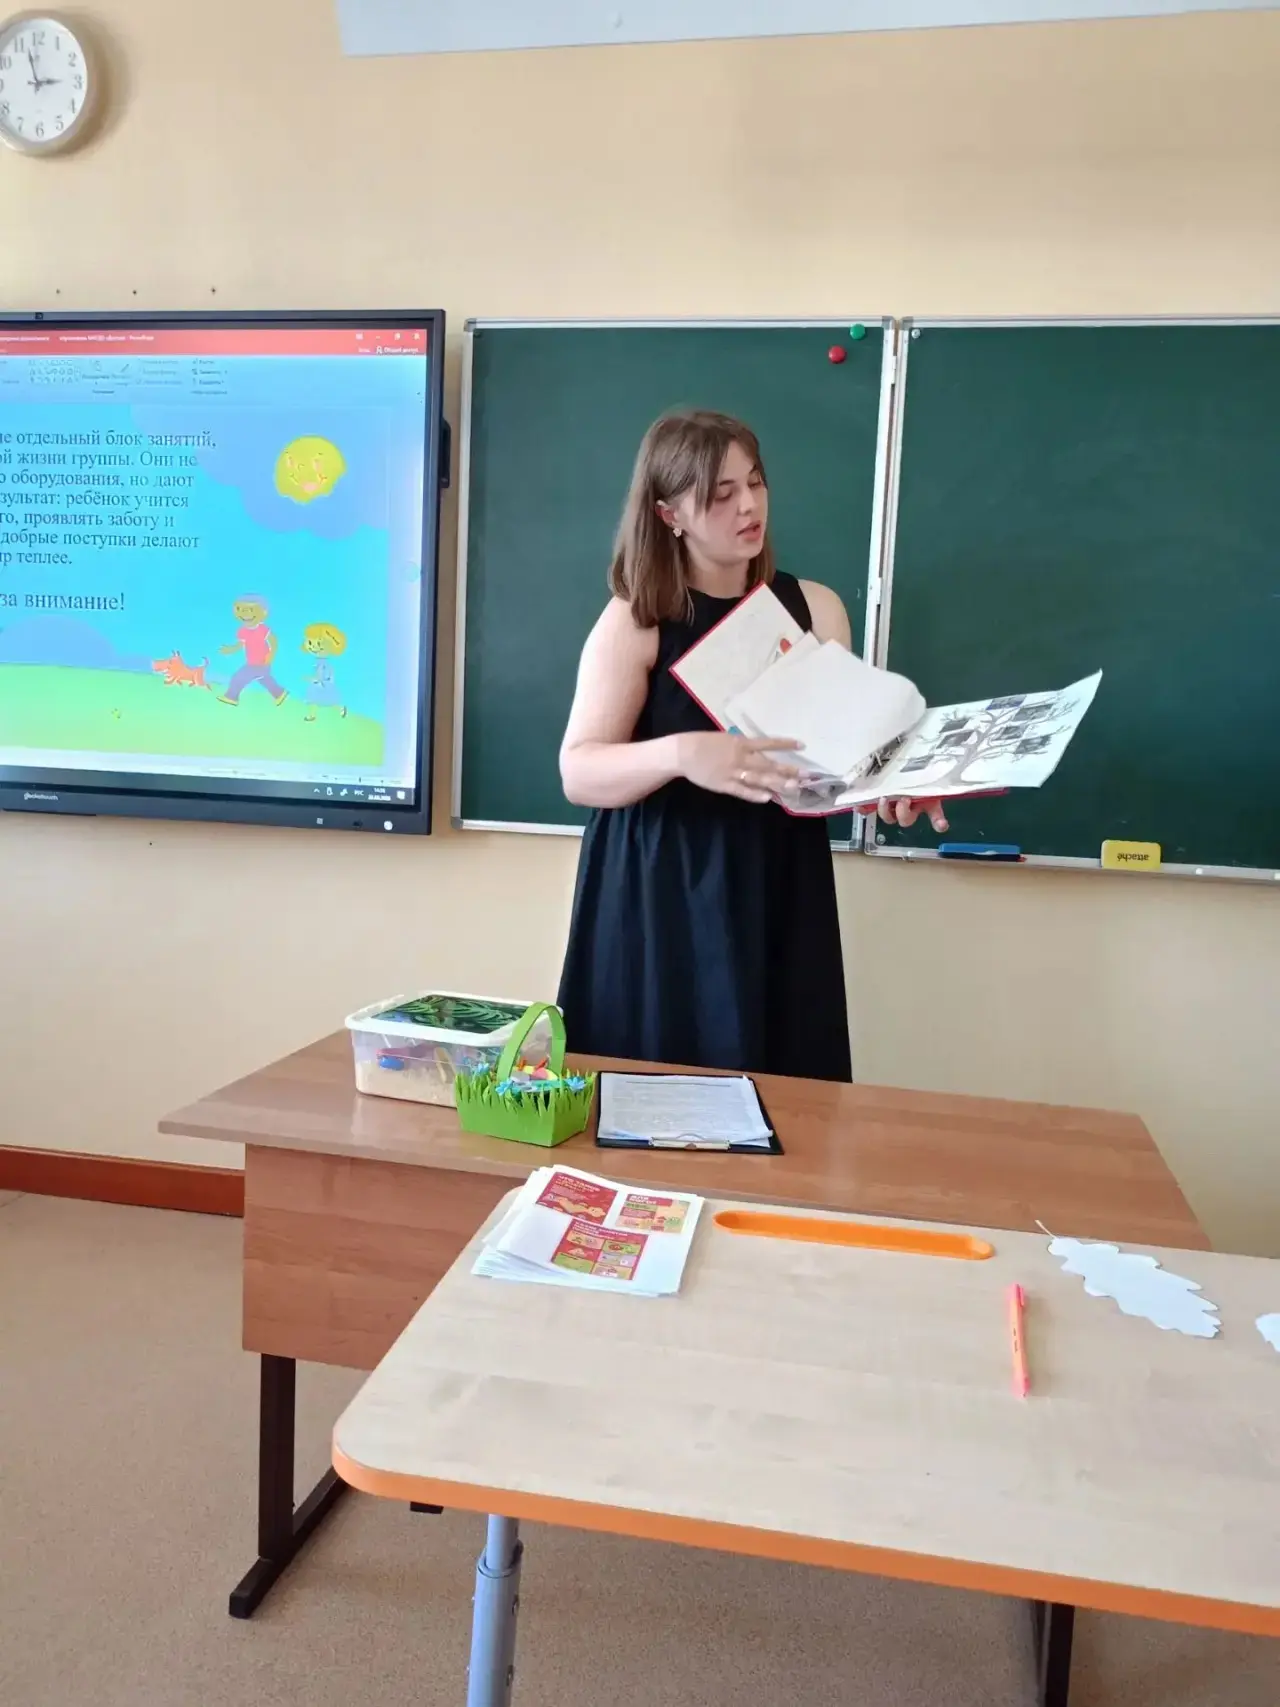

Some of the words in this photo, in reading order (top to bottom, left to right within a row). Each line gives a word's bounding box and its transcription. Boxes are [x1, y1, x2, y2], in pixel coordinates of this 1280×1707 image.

[14, 37, 25, 53] 11
[32, 31, 46, 47] 12
[55, 35, 61, 51] 1
[68, 52, 77, 68] 2
[73, 75, 83, 90] 3
[1, 101, 11, 116] 8
[67, 97, 76, 114] 4
[17, 116, 24, 133] 7
[35, 122, 45, 138] 6
[55, 114, 65, 131] 5
[16, 429, 100, 446] отдельный
[105, 430, 143, 446] блок
[147, 431, 216, 447] занятий,
[0, 449, 12, 464] й
[17, 453, 67, 465] жизни
[71, 454, 134, 469] группы.
[140, 451, 174, 467] Они
[179, 455, 198, 467] не
[11, 469, 124, 488] оборудования,
[129, 475, 149, 486] но
[153, 475, 194, 488] дают
[66, 489, 131, 508] ребёнок
[134, 495, 189, 511] учится
[24, 513, 103, 528] проявлять
[107, 510, 160, 531] заботу
[164, 515, 174, 527] и
[1, 528, 58, 548] добрые
[63, 533, 137, 550] поступки
[141, 535, 200, 549] делают
[16, 552, 72, 565] теплее.
[0, 593, 18, 607] за
[24, 592, 125, 611] внимание!
